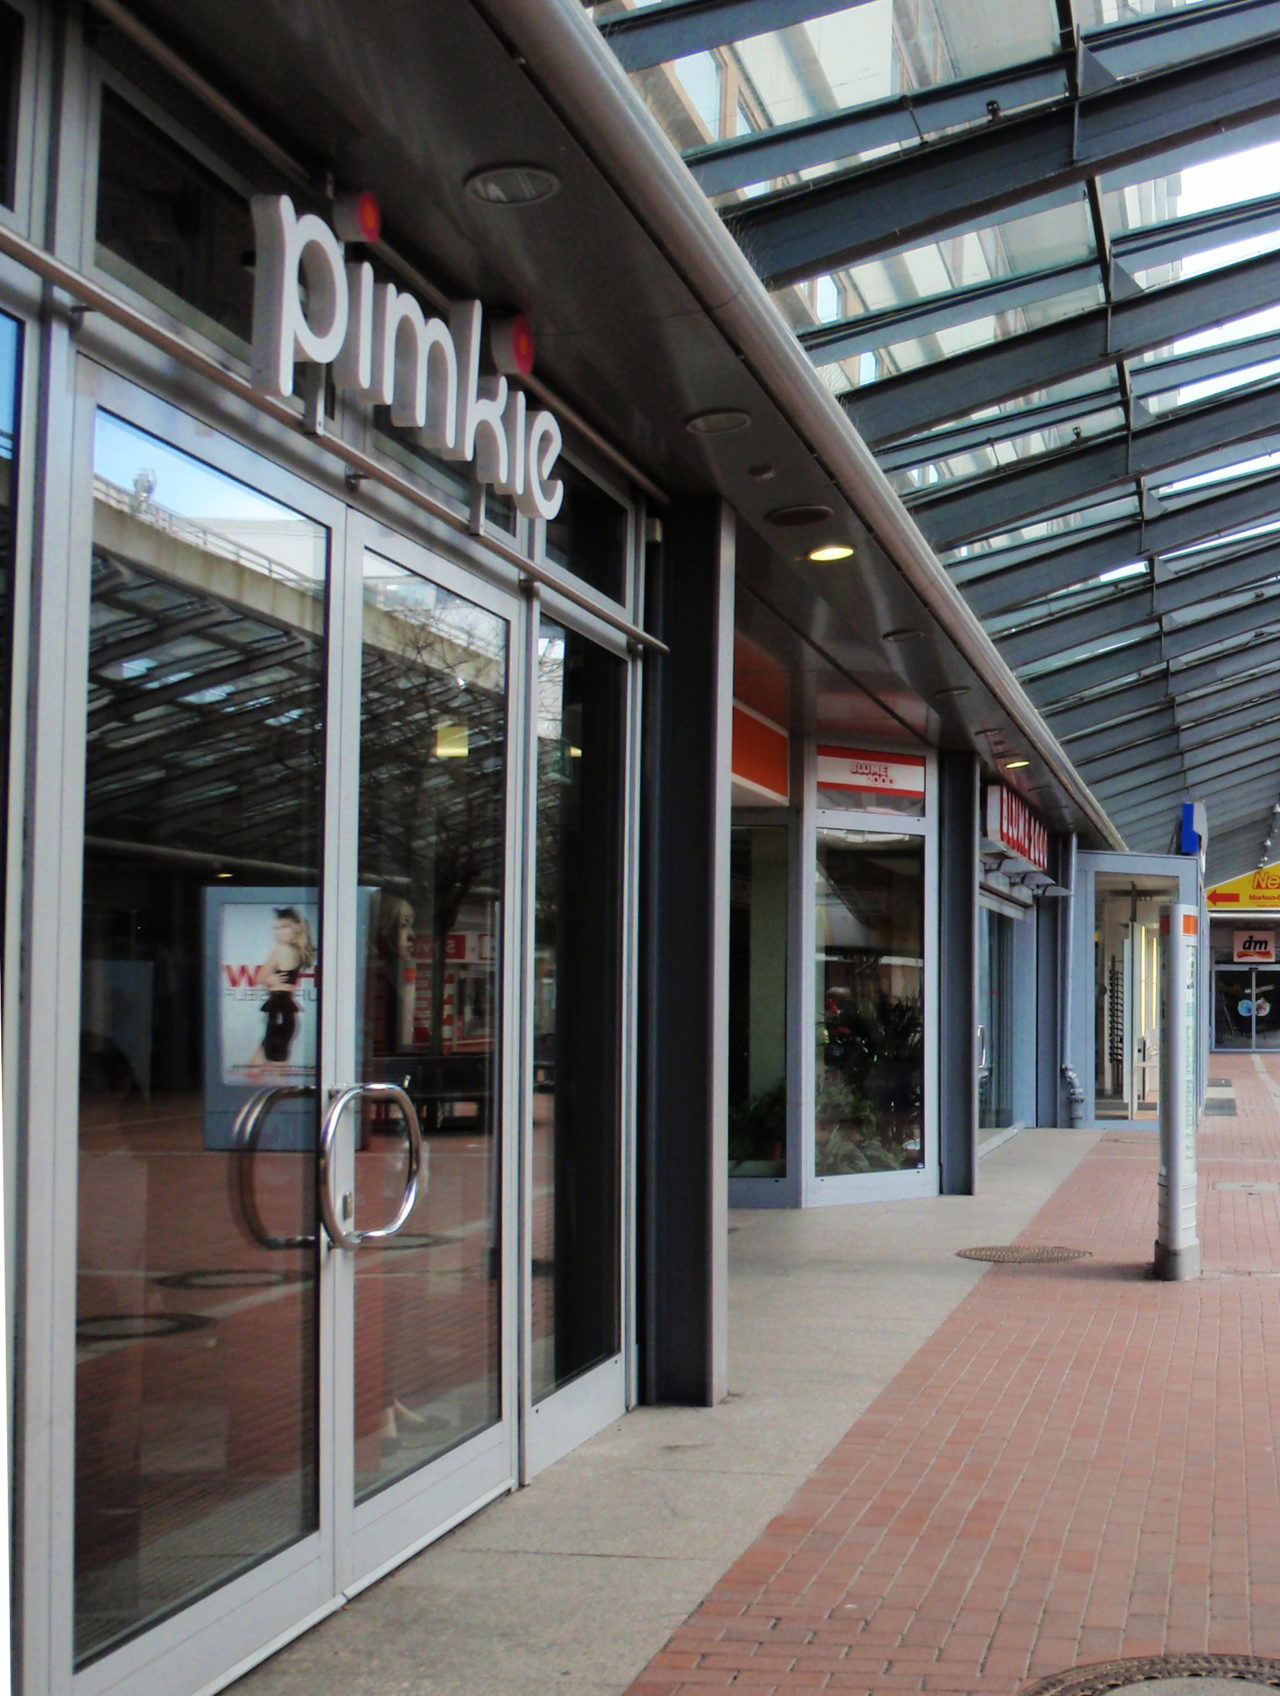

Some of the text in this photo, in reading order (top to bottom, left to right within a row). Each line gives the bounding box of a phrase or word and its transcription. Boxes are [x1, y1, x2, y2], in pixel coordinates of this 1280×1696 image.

[250, 190, 566, 522] pimkie
[850, 760, 889, 777] BLUME
[1242, 935, 1268, 950] dm
